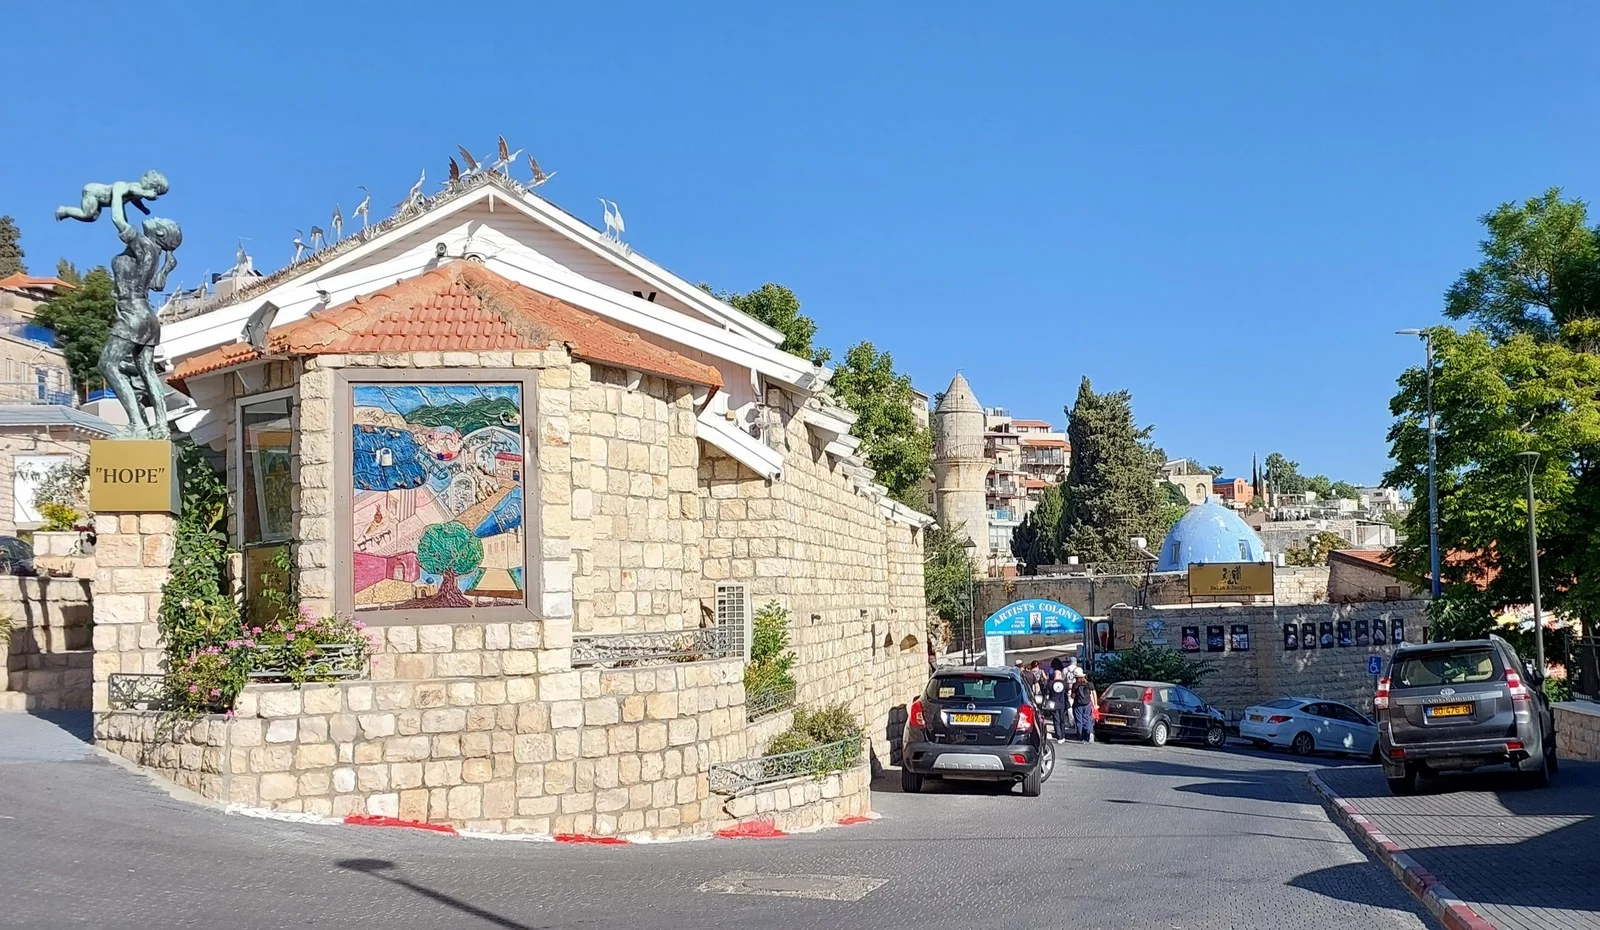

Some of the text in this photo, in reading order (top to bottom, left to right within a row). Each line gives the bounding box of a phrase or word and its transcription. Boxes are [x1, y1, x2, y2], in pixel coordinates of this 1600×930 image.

[95, 467, 165, 484] "HOPE"
[993, 602, 1035, 627] ARTISTS
[1038, 602, 1080, 623] COLONY
